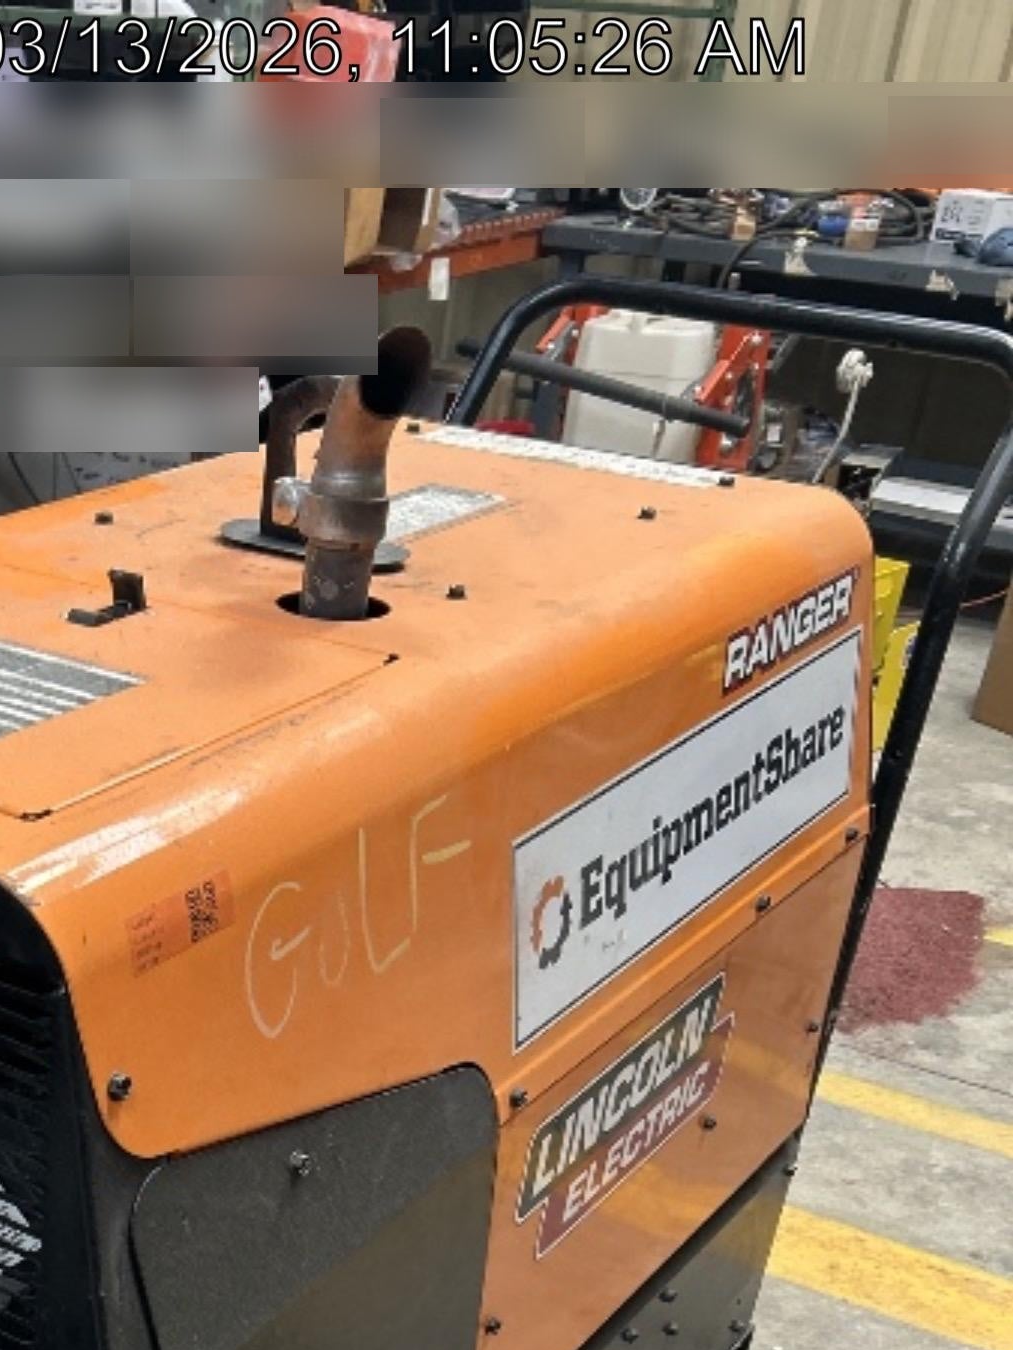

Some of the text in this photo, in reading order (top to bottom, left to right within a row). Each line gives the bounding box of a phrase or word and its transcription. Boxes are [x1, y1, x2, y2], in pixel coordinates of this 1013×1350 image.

[723, 574, 855, 692] RANGER
[577, 703, 847, 930] EquipmentShare
[531, 996, 712, 1197] LINCOLN
[562, 1060, 711, 1223] ELECTRIC
